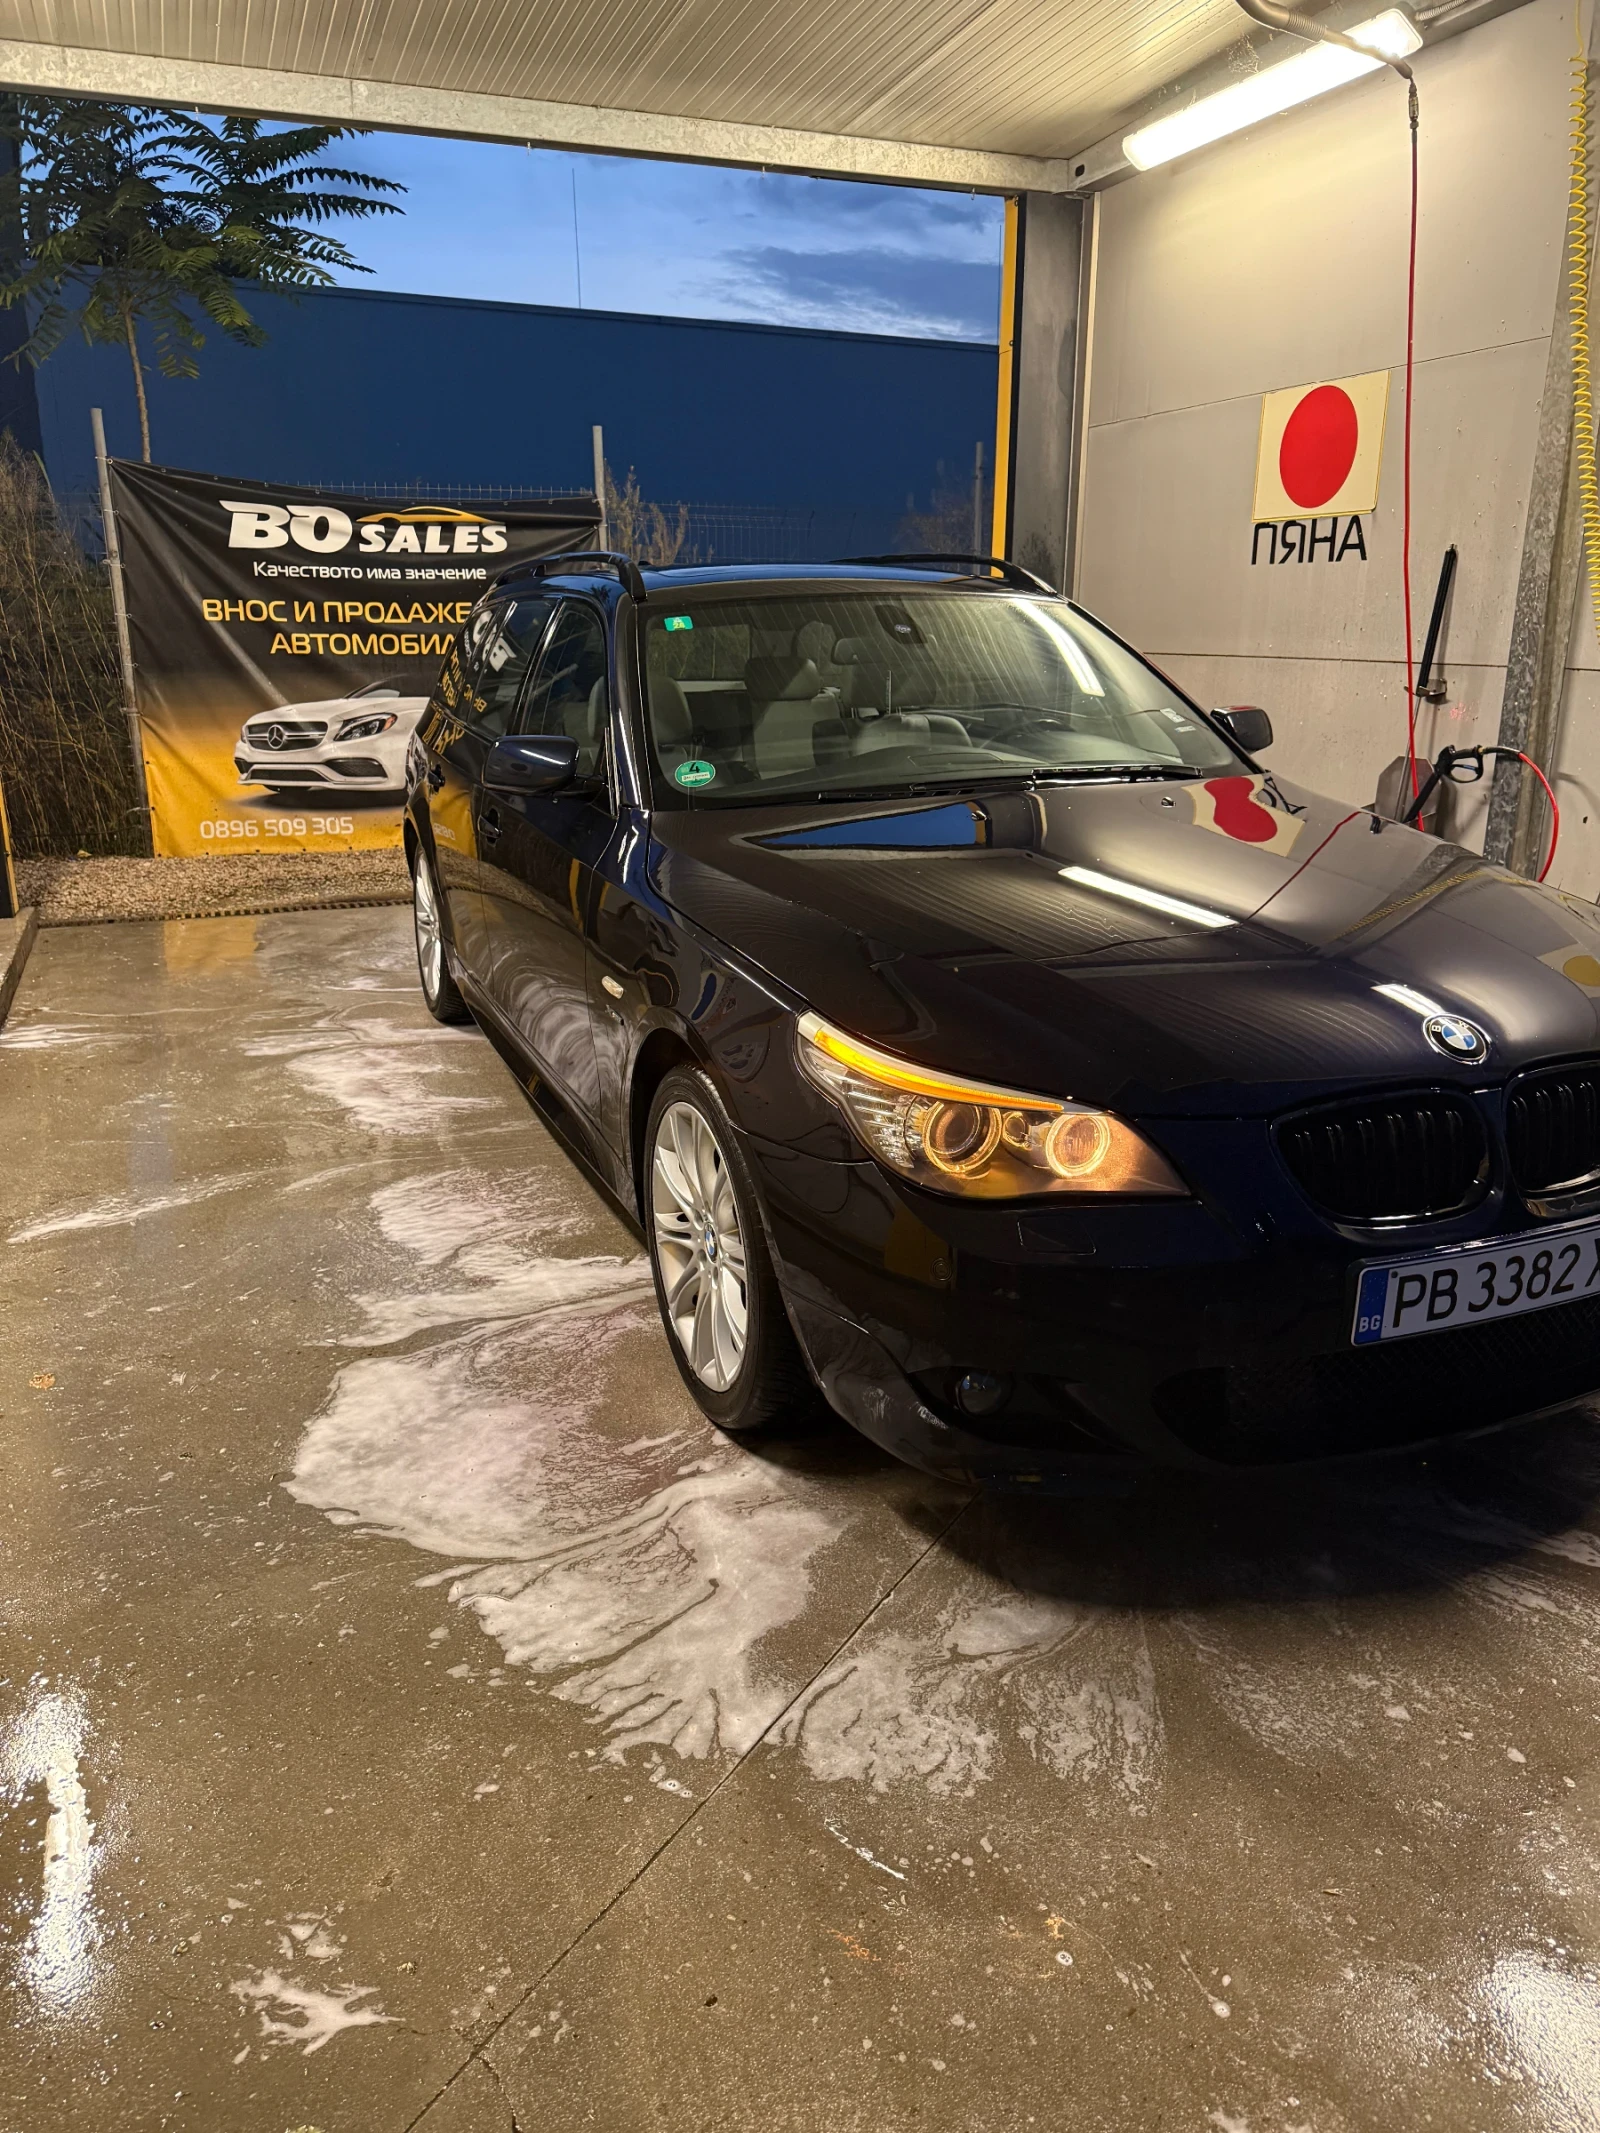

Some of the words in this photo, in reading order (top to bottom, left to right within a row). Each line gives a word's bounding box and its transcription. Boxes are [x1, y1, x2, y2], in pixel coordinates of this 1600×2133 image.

[219, 500, 353, 553] BO
[358, 524, 508, 553] SALES
[1251, 515, 1368, 565] ПЯНА
[253, 561, 363, 579] Качеството
[366, 567, 401, 580] има
[405, 568, 487, 580] значение
[202, 599, 288, 622] ВНОС
[294, 601, 316, 623] И
[689, 762, 700, 773] 4
[200, 820, 259, 839] 0896
[264, 818, 307, 837] 509
[312, 816, 354, 835] 305
[1392, 1268, 1459, 1328] PB
[1467, 1243, 1581, 1313] 3382
[1358, 1314, 1381, 1333] BG
